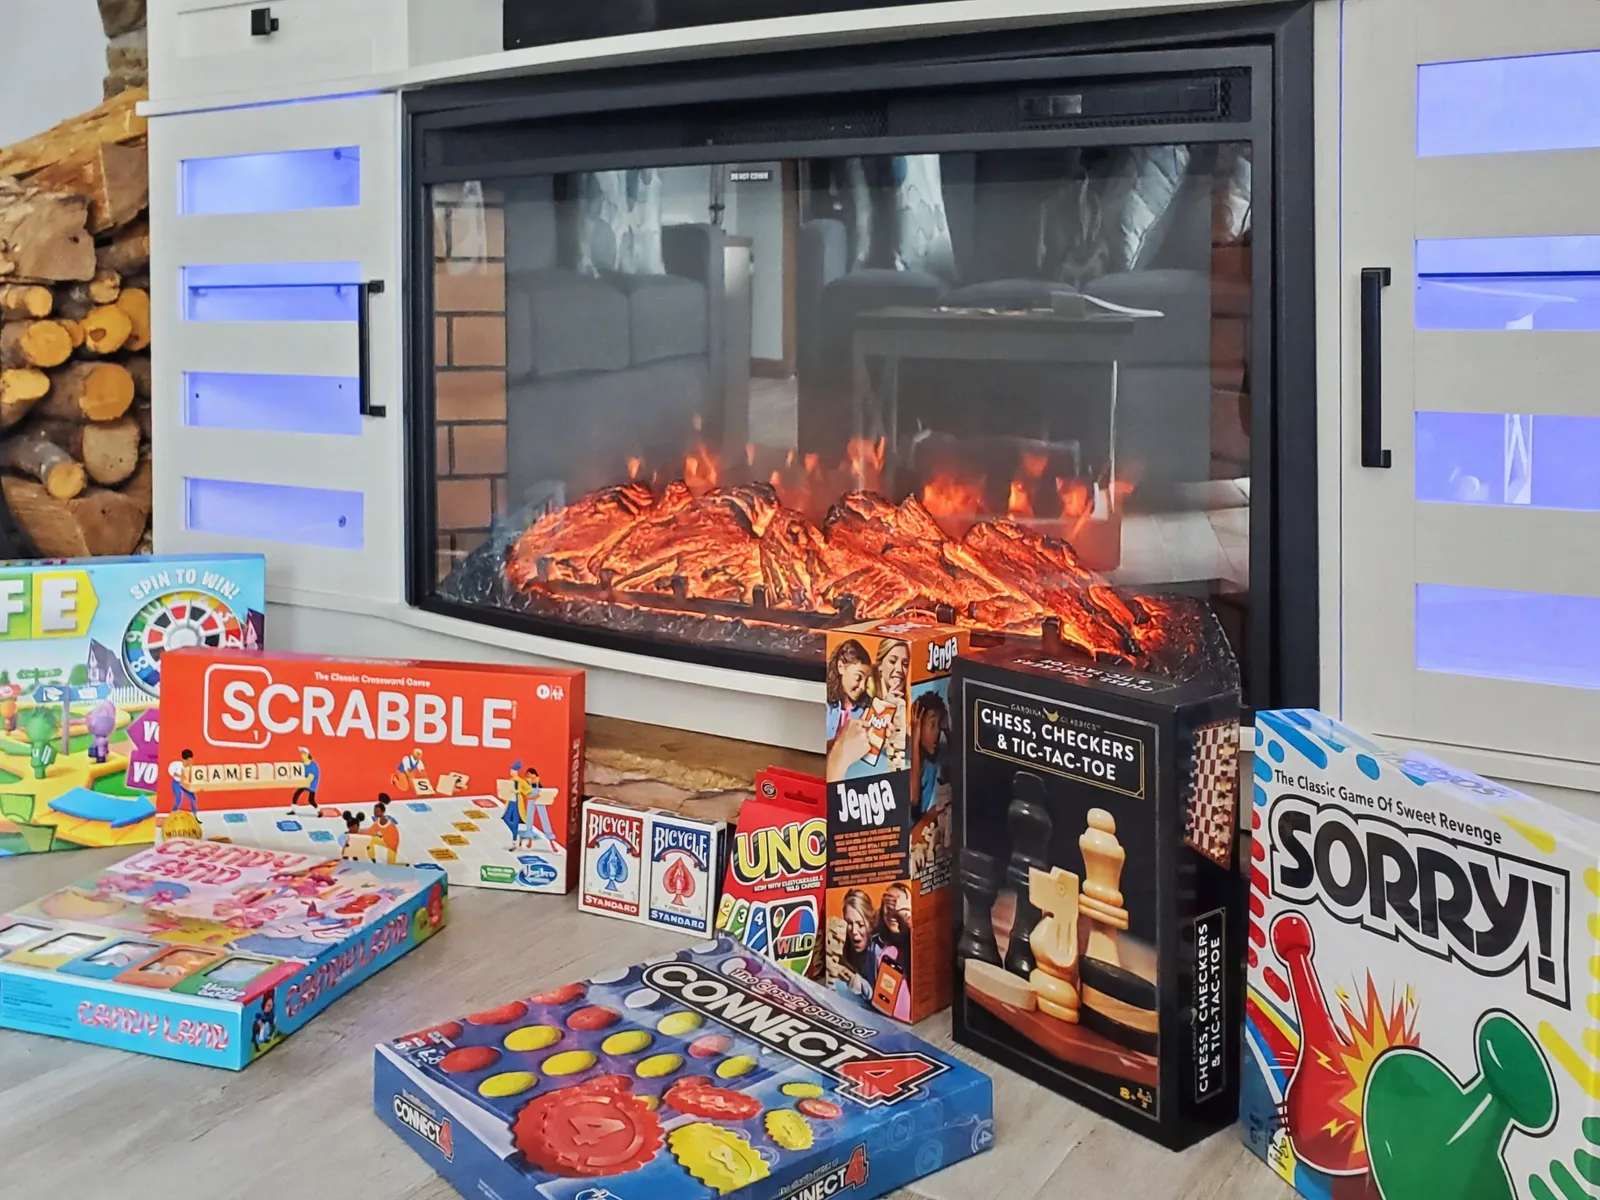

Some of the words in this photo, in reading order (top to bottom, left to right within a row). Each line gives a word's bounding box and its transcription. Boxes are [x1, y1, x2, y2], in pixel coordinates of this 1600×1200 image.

[130, 571, 171, 600] SPIN
[176, 569, 196, 585] TO
[202, 571, 240, 601] WIN!
[130, 656, 149, 673] 8
[927, 636, 958, 671] Jenga
[314, 671, 329, 682] The
[331, 673, 360, 684] Classic
[361, 674, 405, 686] Crossword
[221, 681, 513, 749] SCRABBLE
[981, 708, 1037, 741] CHESS,
[1041, 724, 1135, 762] CHECKERS
[194, 767, 253, 781] GAME
[278, 765, 303, 777] ON
[997, 734, 1008, 751] &
[1012, 737, 1117, 781] TIC-TAC-TOE
[417, 780, 429, 791] S
[837, 779, 897, 826] Jenga
[1274, 769, 1295, 787] The
[1297, 774, 1336, 798] Classic
[1338, 786, 1374, 807] Game
[1377, 796, 1394, 814] Of
[1396, 801, 1437, 825] Sweet
[1439, 813, 1502, 846] Revenge
[157, 838, 307, 872] CANDY
[588, 812, 641, 857] BICYCLE
[654, 826, 708, 868] BICYCLE
[736, 820, 827, 878] UNO
[585, 894, 638, 914] STANDARD
[720, 901, 731, 917] 2
[737, 908, 748, 924] 3
[754, 911, 764, 926] 4
[1277, 809, 1557, 986] SORRY!
[651, 909, 706, 930] STANDARD
[776, 935, 816, 956] WILD
[1198, 923, 1208, 1022] CHECKERS
[1211, 936, 1221, 1051] TIC-TAC-TOE
[78, 1000, 159, 1036] CANDY
[163, 1015, 229, 1051] LAND
[652, 965, 869, 1068] CONNECT
[834, 1057, 935, 1099] 4
[1198, 1026, 1209, 1092] CHESS,
[1211, 1054, 1221, 1067] &
[395, 1097, 441, 1145] CONNECT
